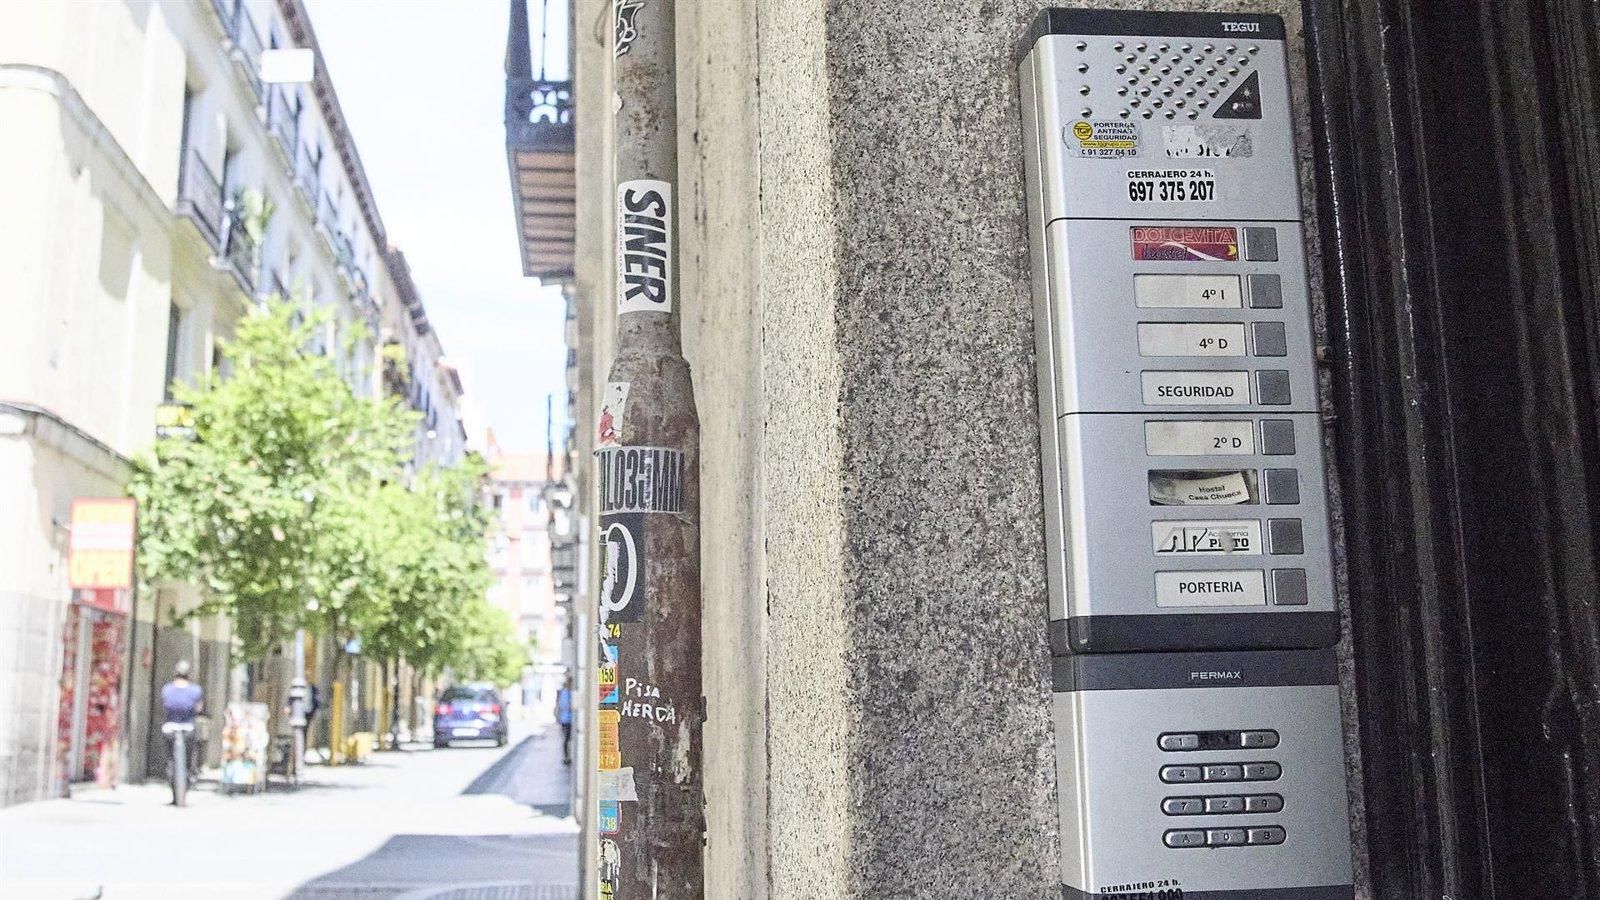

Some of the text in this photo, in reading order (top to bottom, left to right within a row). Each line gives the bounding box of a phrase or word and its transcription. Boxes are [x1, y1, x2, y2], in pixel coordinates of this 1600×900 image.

[1221, 22, 1260, 32] TEGUI
[1128, 170, 1187, 178] CERRAJERO
[1129, 180, 1214, 201] 697 375 207
[1133, 228, 1235, 243] DOLCEVITA
[624, 188, 667, 304] SINER
[1218, 339, 1228, 349] D
[1157, 386, 1234, 397] SEGURIDAD
[1232, 437, 1242, 448] D
[1198, 485, 1226, 493] Hostal
[1210, 491, 1242, 500] Chueca
[1179, 582, 1244, 594] PORTERIA
[1191, 671, 1241, 680] FERMAX
[1179, 770, 1186, 778] 4
[1220, 769, 1227, 777] 5
[1181, 800, 1268, 811] 7 2 9
[1183, 835, 1190, 843] A
[1100, 881, 1155, 893] CERRAJERO
[1157, 880, 1169, 888] 24
